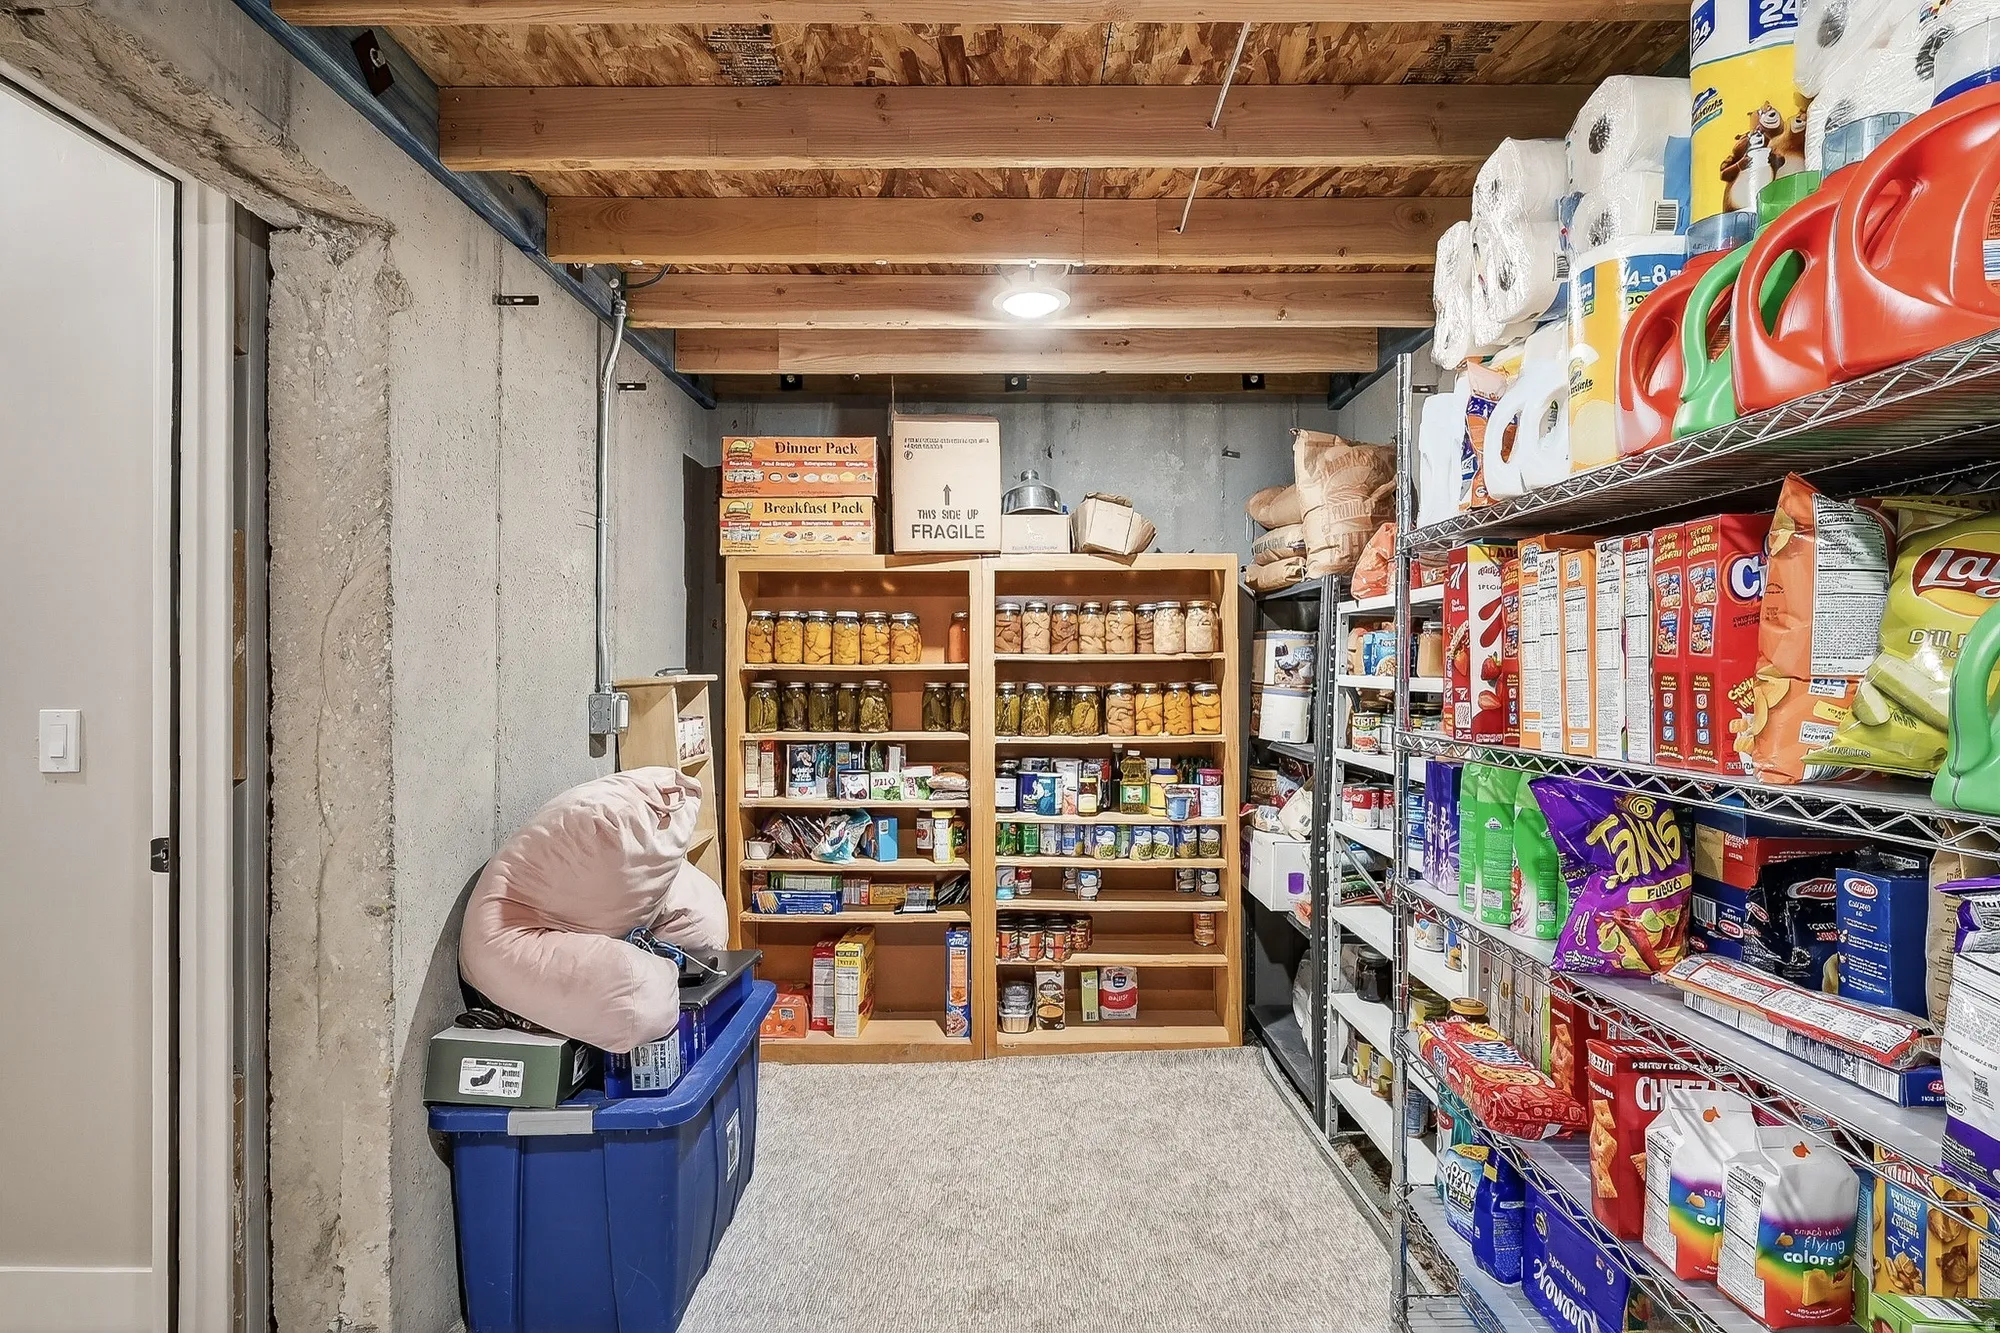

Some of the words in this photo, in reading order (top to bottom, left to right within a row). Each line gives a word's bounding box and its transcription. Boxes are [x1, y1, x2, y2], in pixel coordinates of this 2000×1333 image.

[775, 441, 822, 454] Dinner
[826, 441, 858, 454] Pack
[764, 501, 827, 514] Breakfast
[832, 501, 863, 514] Pack
[917, 509, 937, 520] THIS
[941, 509, 961, 520] SIDE
[967, 509, 979, 520] UP
[911, 524, 985, 539] FRAGILE
[1909, 629, 1951, 648] Dill
[1697, 1214, 1721, 1227] col
[1804, 1236, 1845, 1254] flying
[1783, 1249, 1835, 1266] colors
